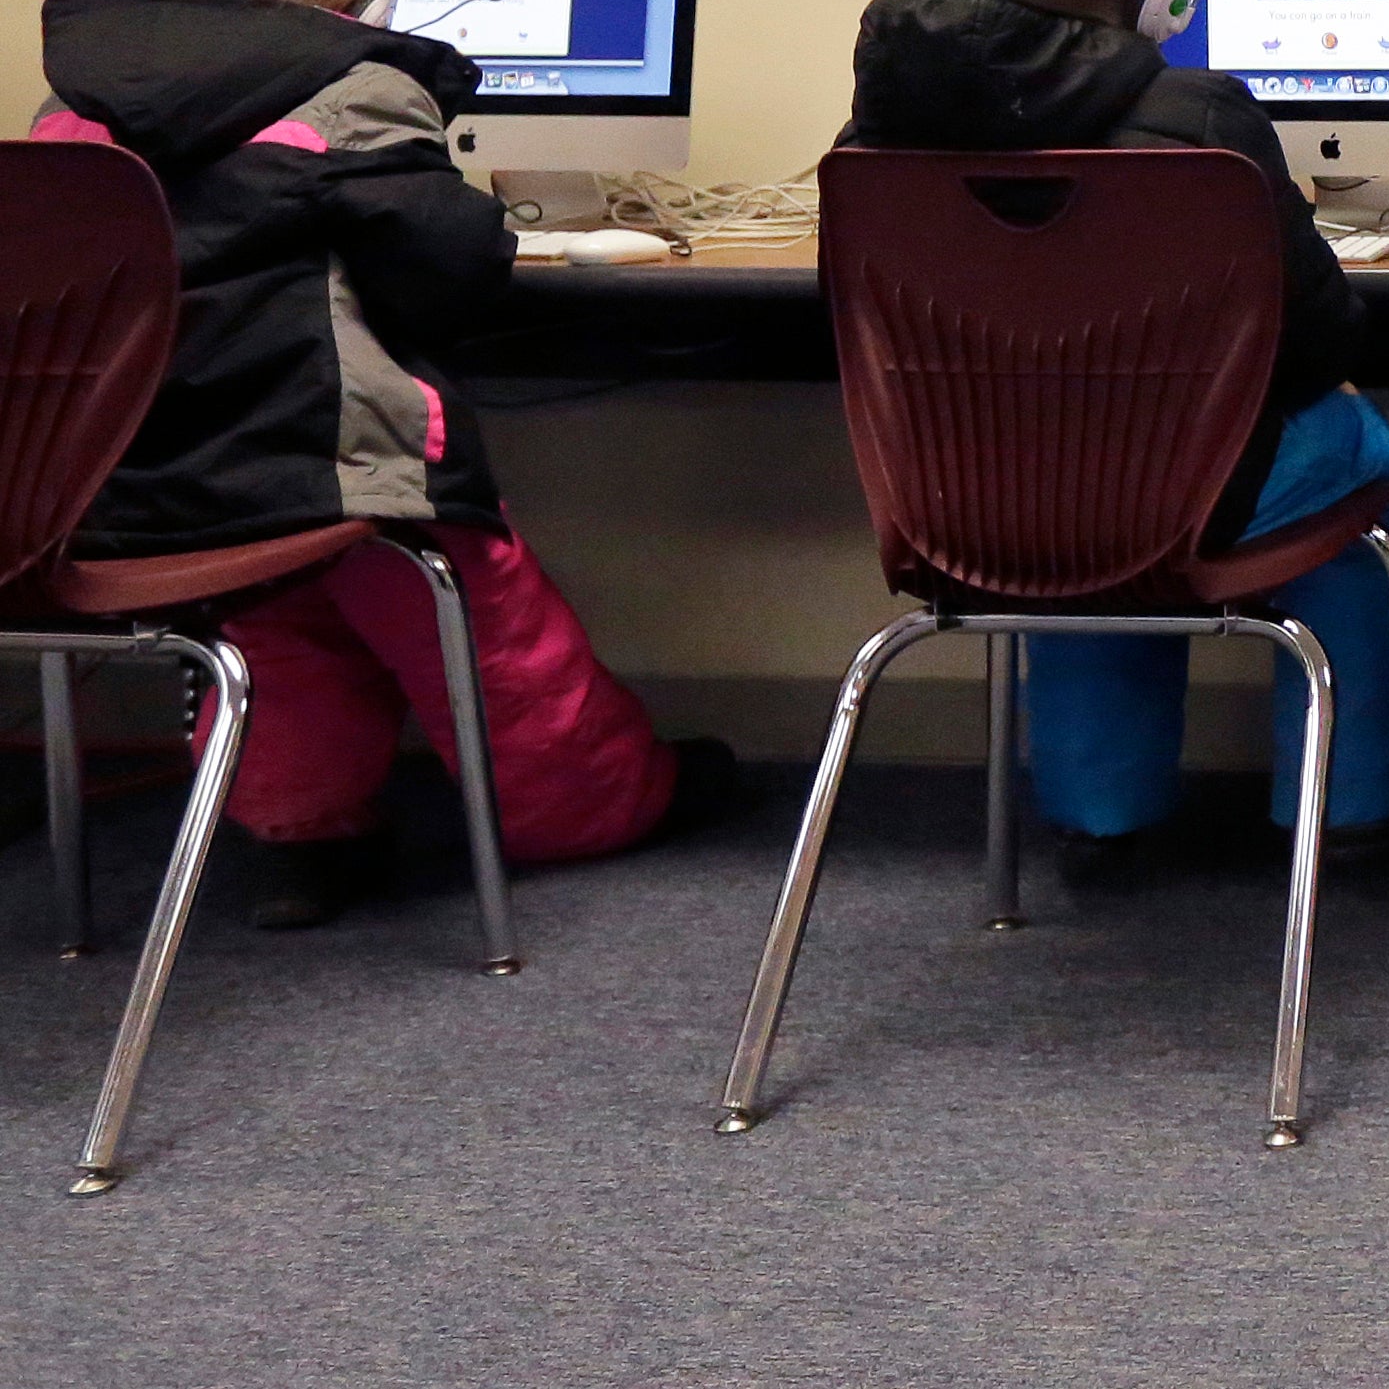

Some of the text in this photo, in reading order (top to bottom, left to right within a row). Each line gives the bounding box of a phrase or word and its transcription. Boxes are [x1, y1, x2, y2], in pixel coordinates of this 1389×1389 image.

[1268, 10, 1286, 20] You
[1289, 12, 1307, 20] can
[1309, 12, 1323, 23] go
[1325, 12, 1338, 20] on
